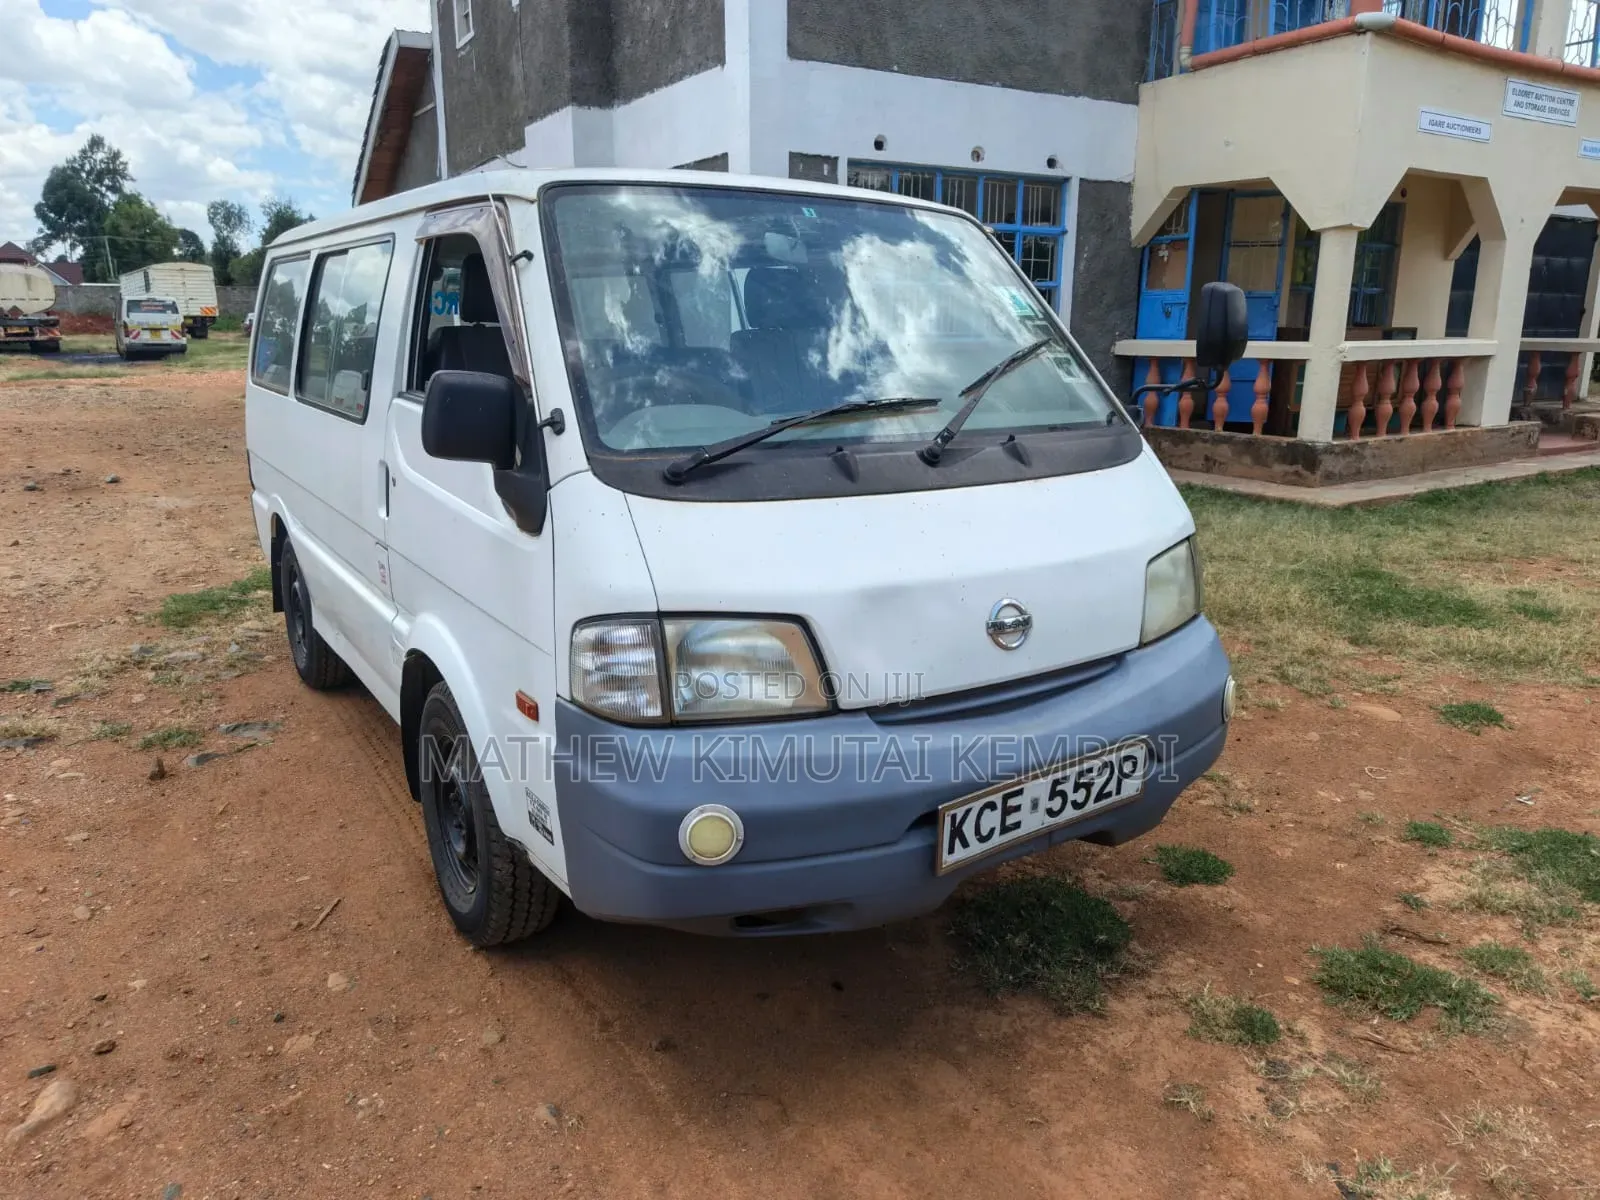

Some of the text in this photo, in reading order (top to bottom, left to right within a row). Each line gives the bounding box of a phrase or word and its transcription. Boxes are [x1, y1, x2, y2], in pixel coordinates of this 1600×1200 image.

[1511, 88, 1576, 107] ELDORET AUCTION CENTRE
[1513, 100, 1571, 117] AND STORAGE SERVICES
[1446, 121, 1482, 135] AUCTIONEERS
[947, 755, 1139, 856] KCE 552P
